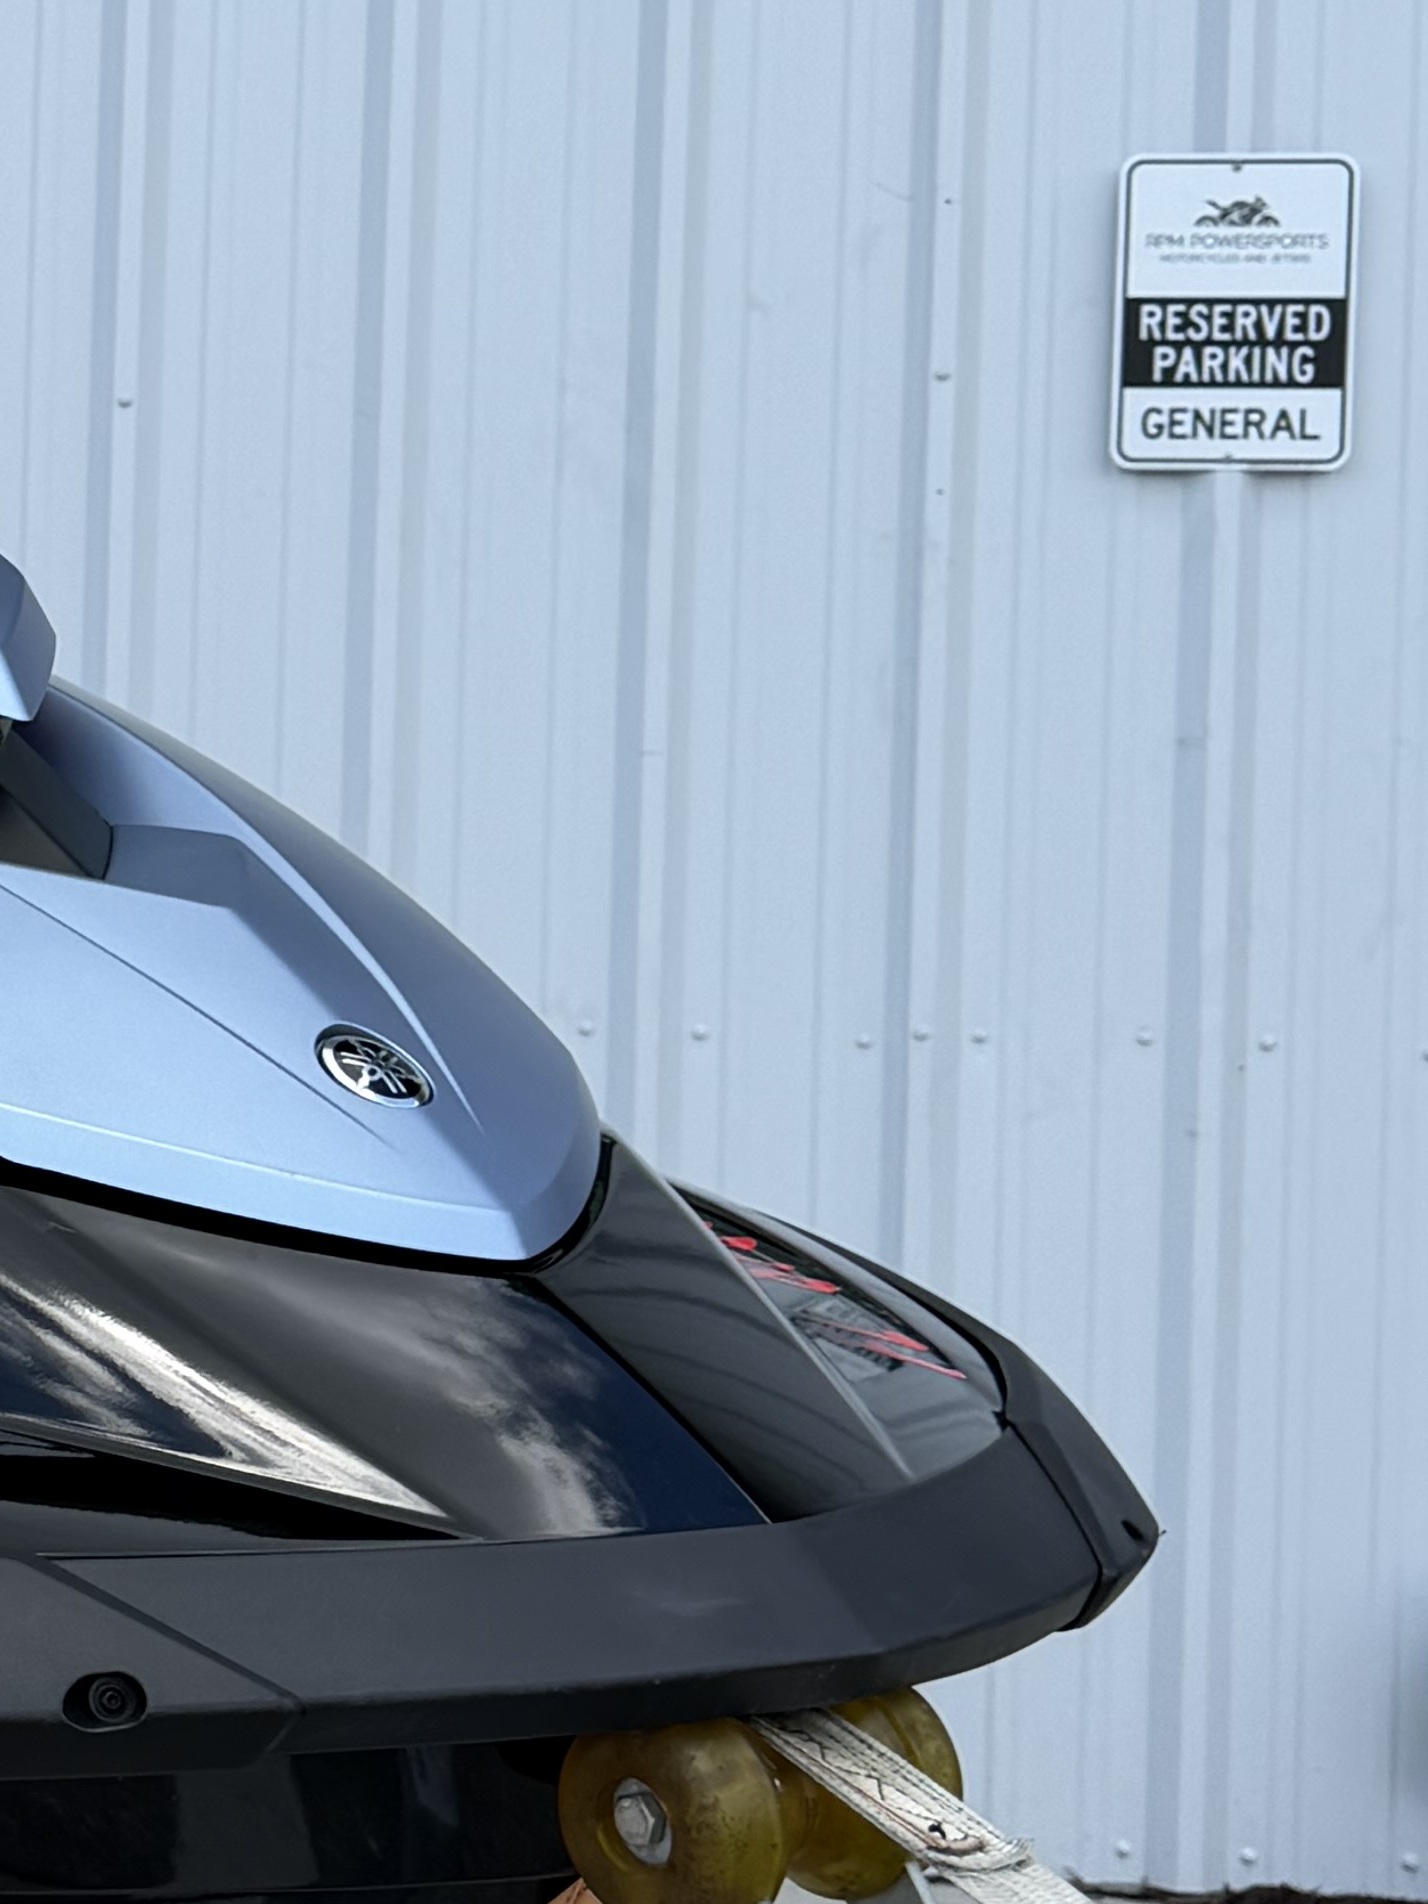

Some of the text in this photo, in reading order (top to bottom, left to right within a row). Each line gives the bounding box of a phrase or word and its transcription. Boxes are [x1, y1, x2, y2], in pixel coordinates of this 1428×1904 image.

[1138, 303, 1332, 342] RESERVED
[1152, 345, 1317, 384] PARKING
[1140, 406, 1322, 441] GENERAL
